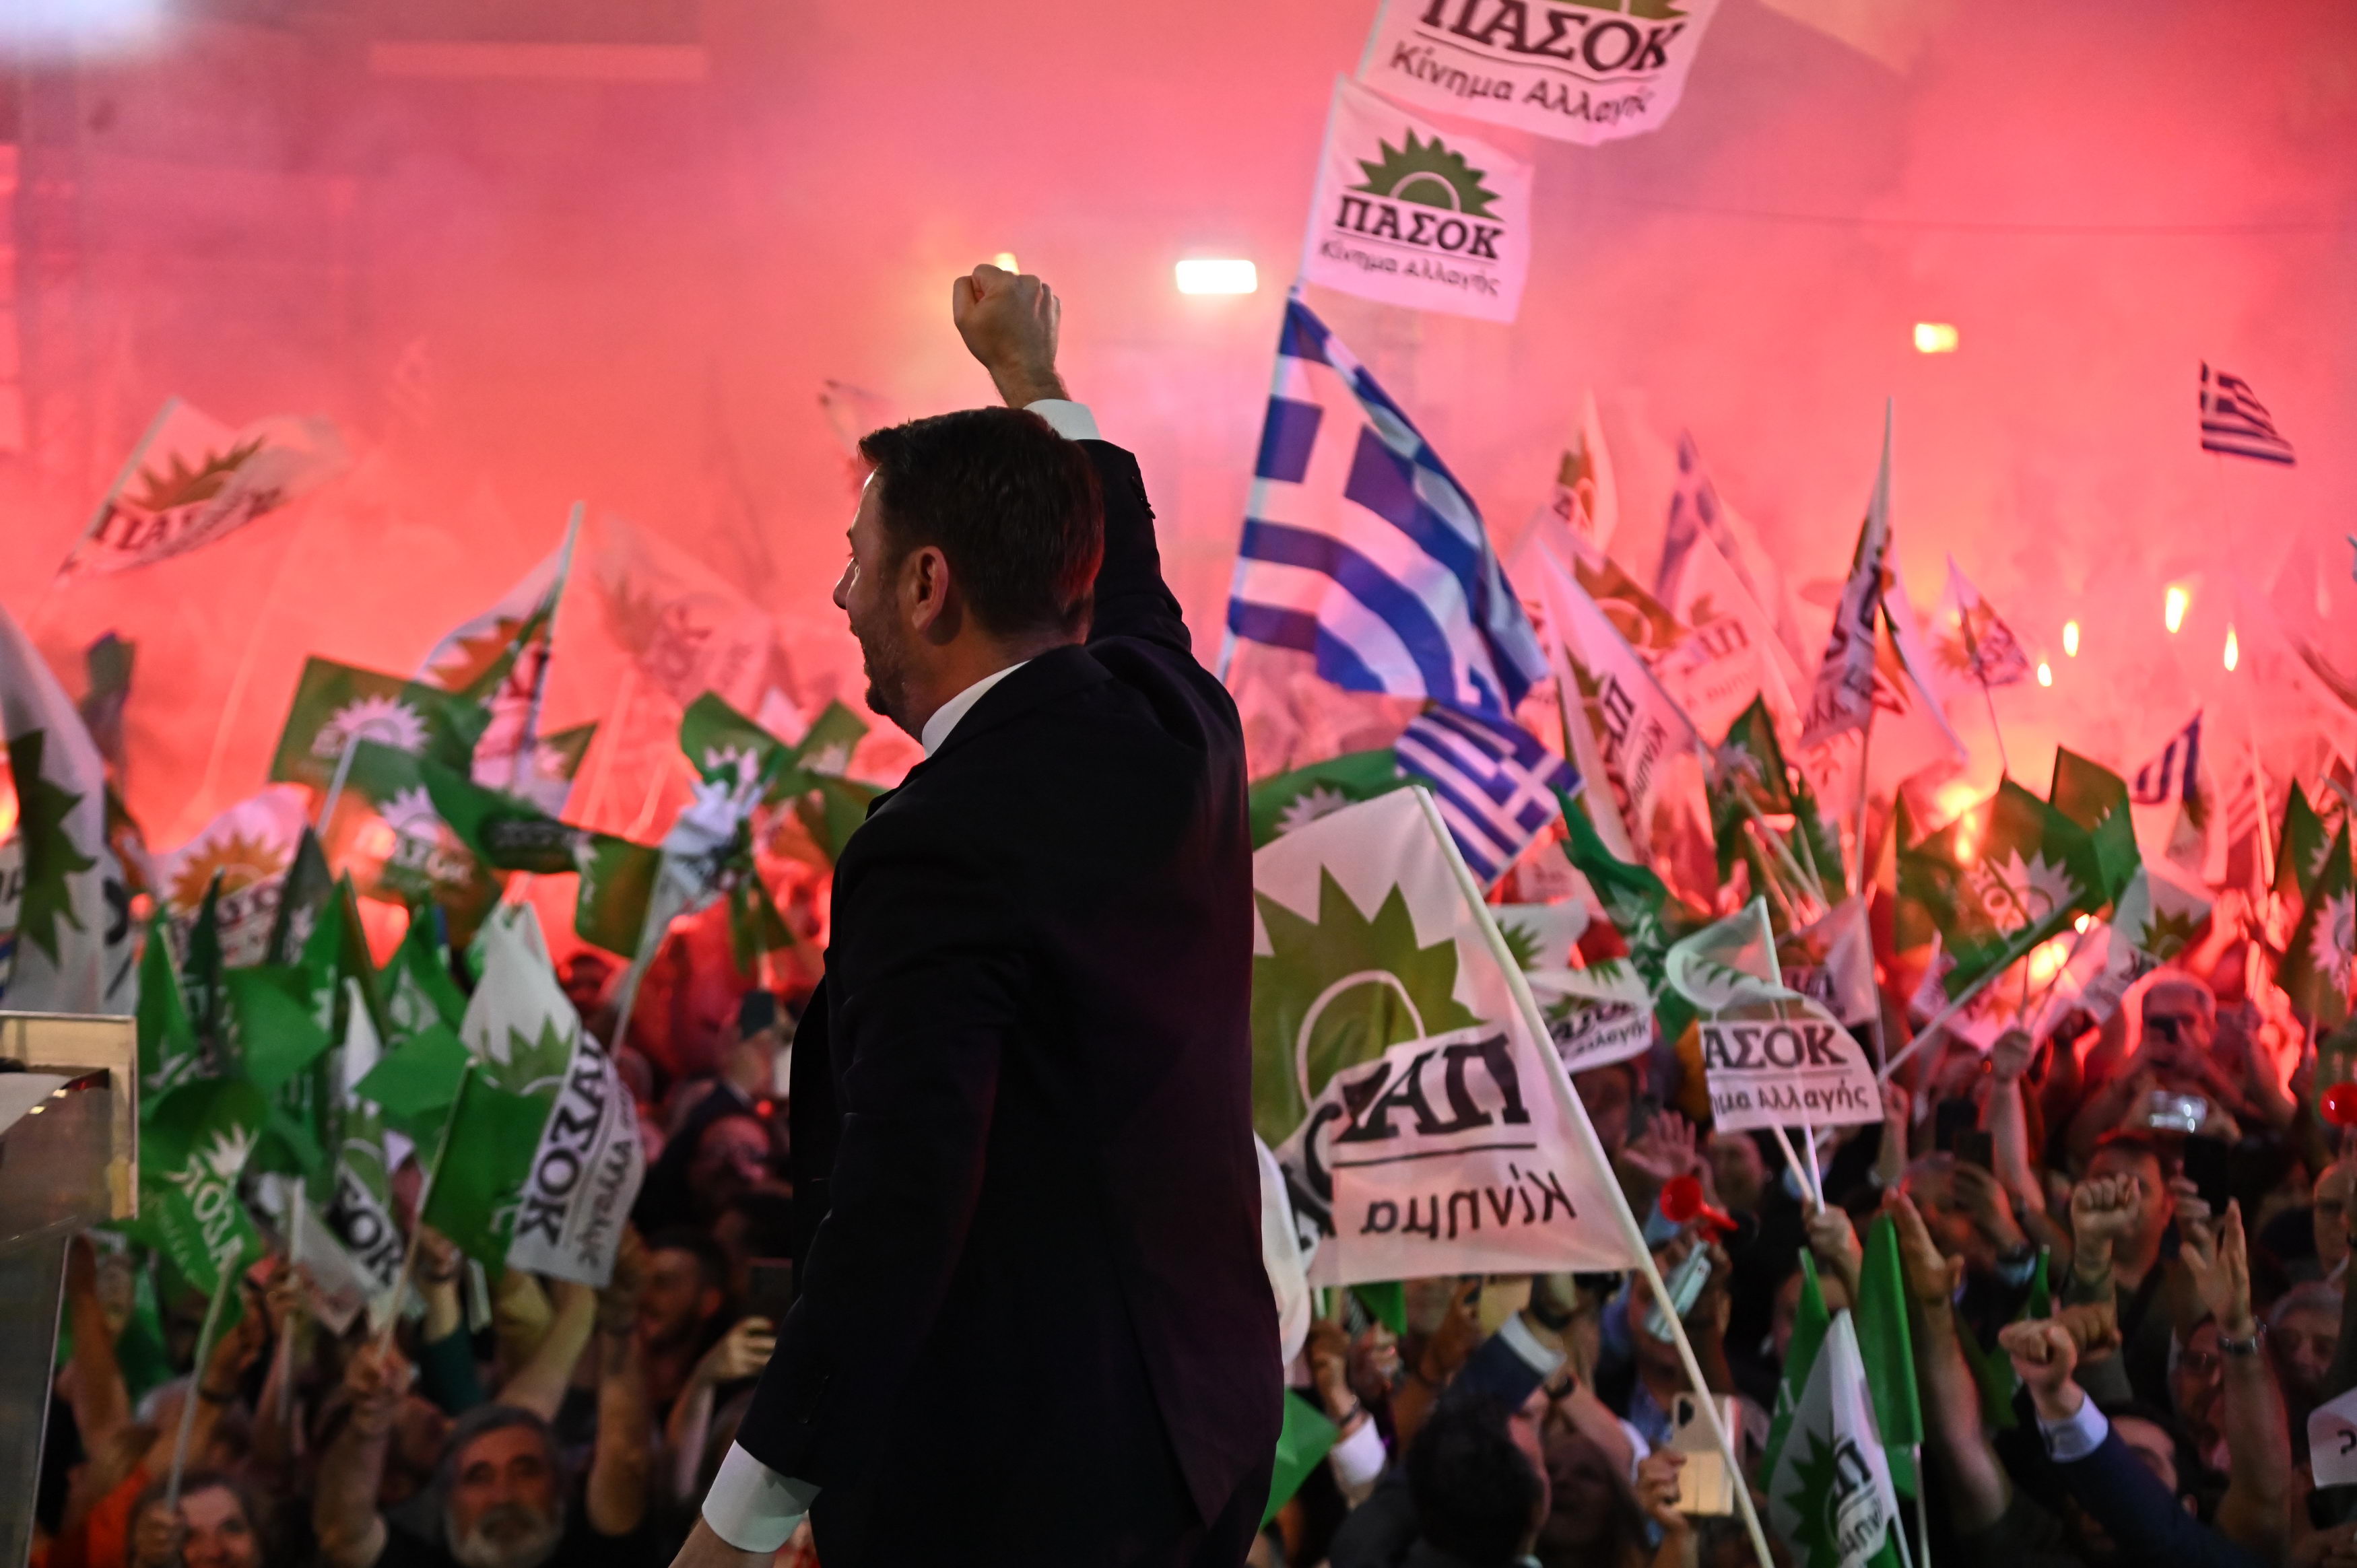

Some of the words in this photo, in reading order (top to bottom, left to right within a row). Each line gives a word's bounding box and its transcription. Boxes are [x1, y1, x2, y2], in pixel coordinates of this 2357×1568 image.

[1389, 40, 1514, 100] Κίνημα
[1335, 194, 1505, 260] ΠΑΣΟΚ
[1703, 1024, 1848, 1069] ΑΣΟΚ
[1758, 1079, 1869, 1115] Αλλαγής
